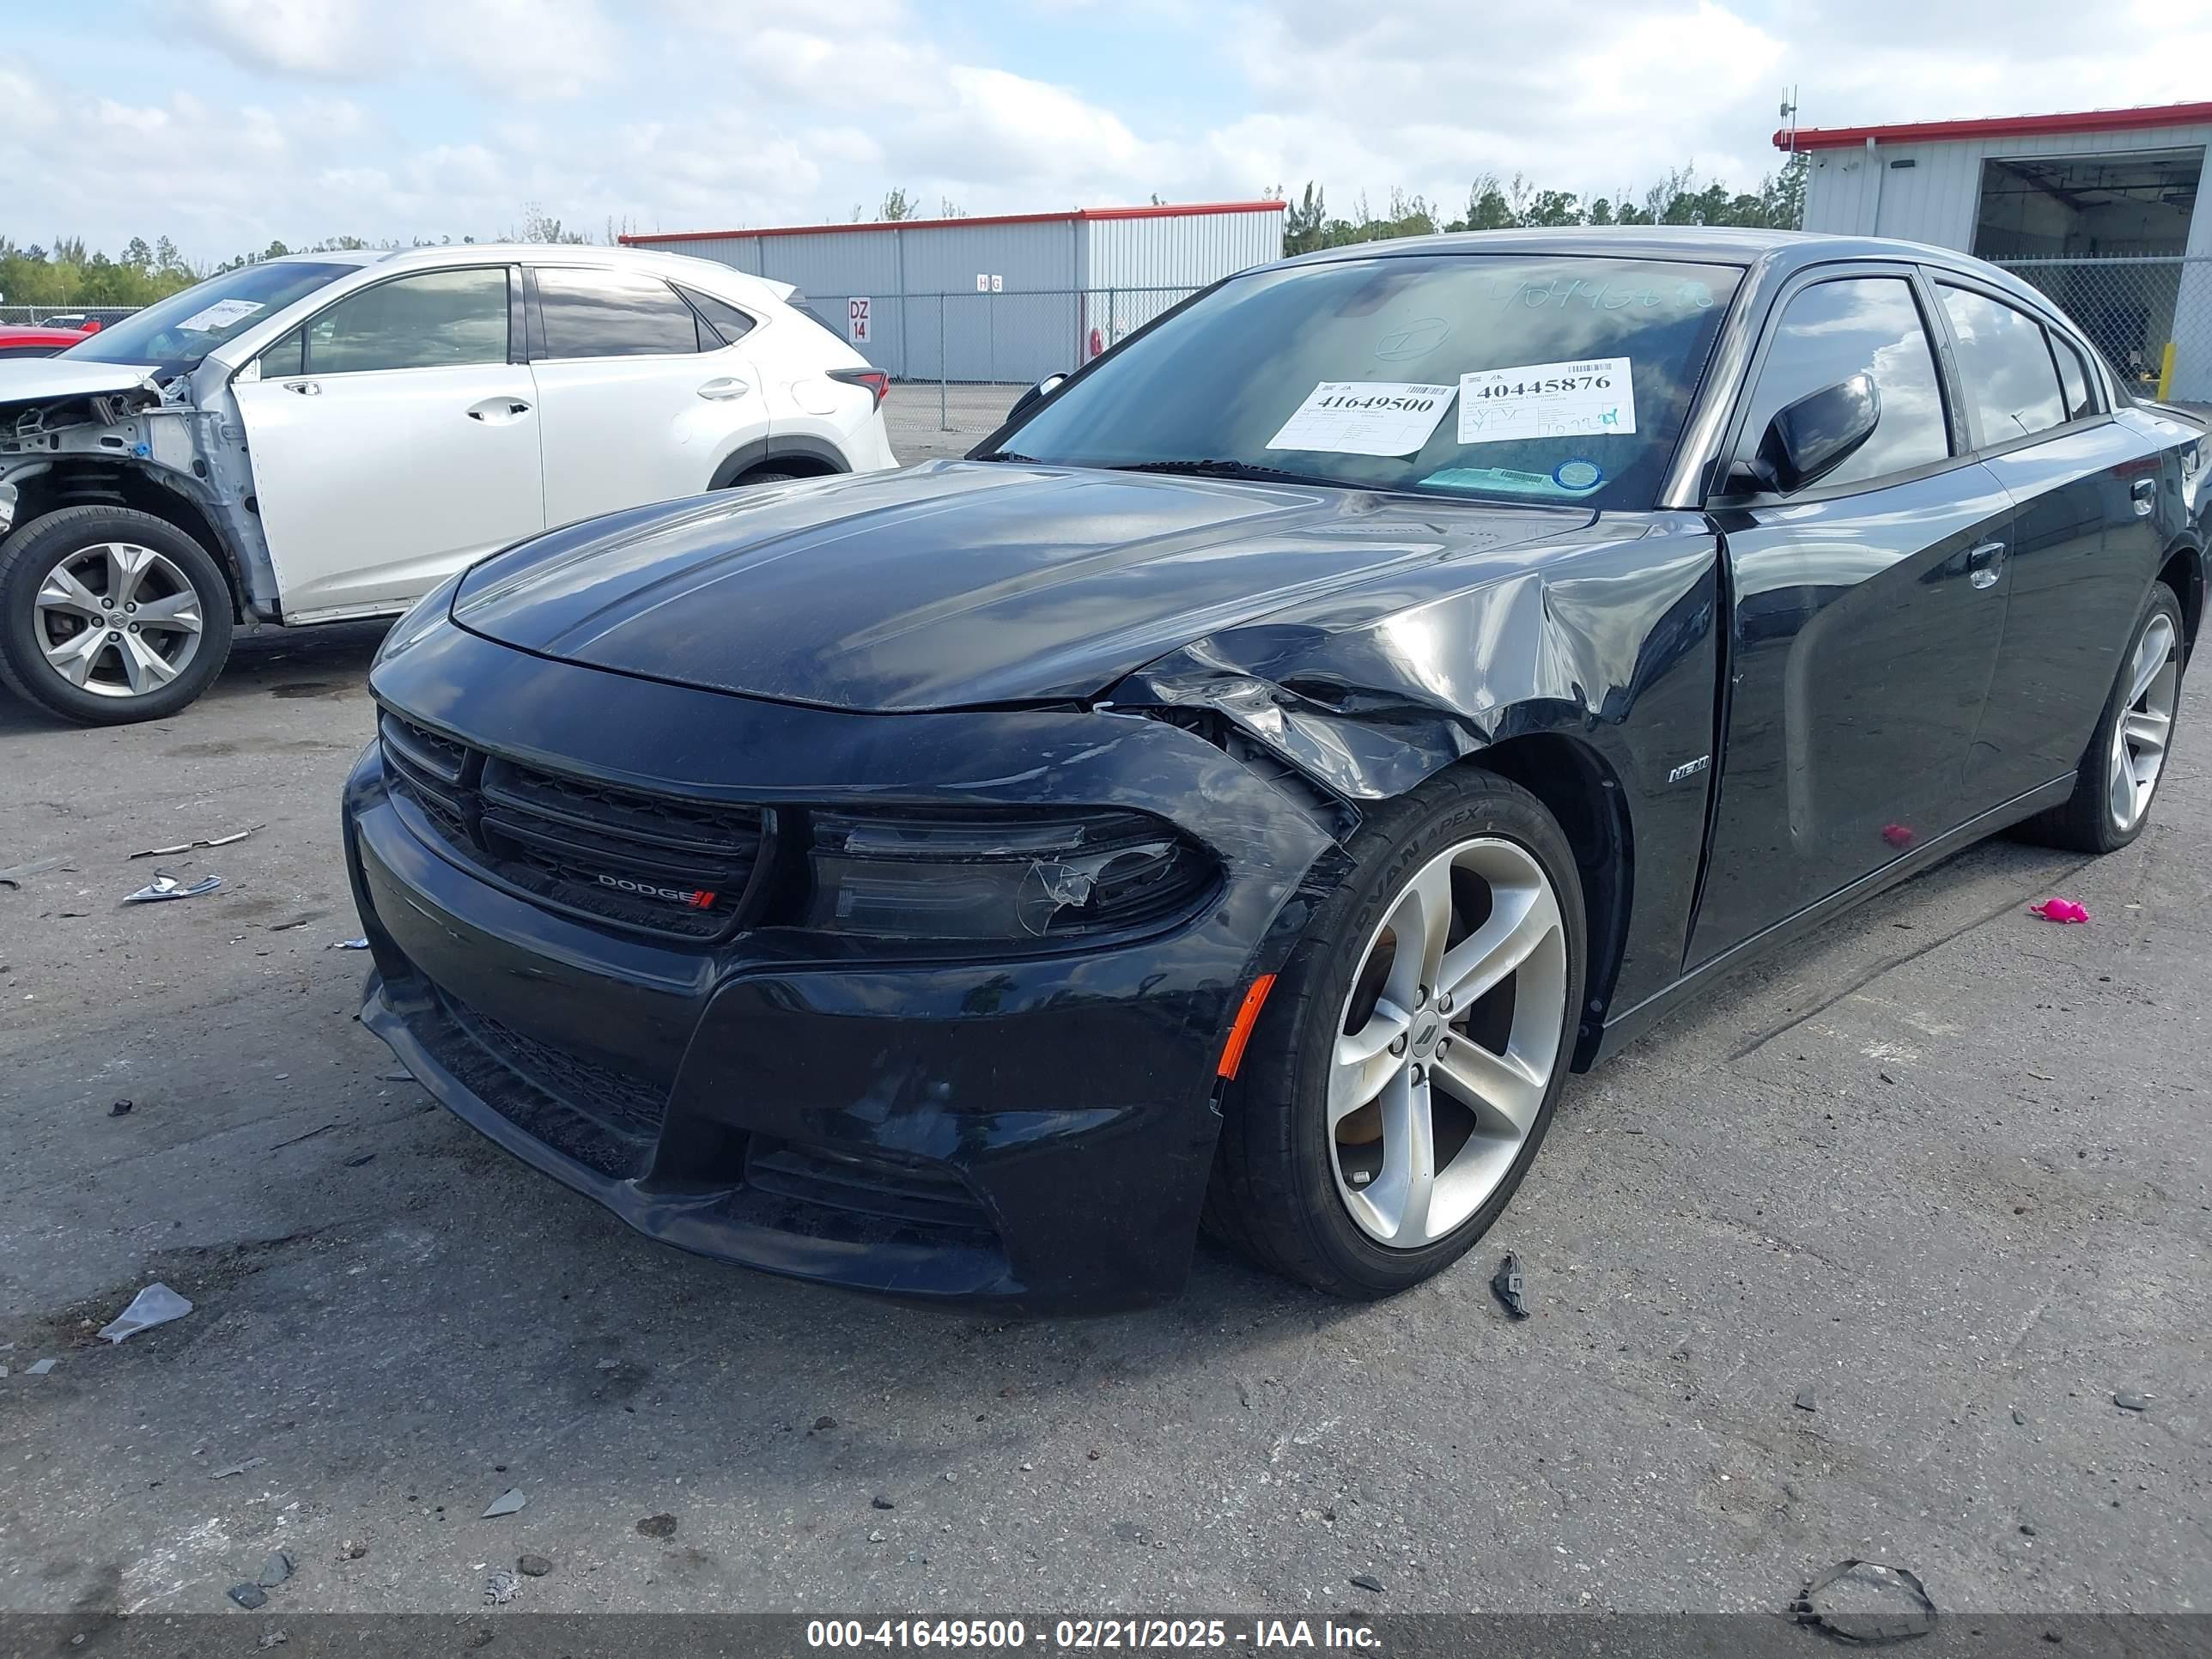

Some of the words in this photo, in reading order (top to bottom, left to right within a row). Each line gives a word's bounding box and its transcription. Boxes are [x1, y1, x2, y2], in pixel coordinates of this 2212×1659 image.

[980, 277, 987, 289] H
[992, 277, 1000, 289] G
[850, 301, 869, 319] DZ
[854, 321, 866, 339] 14
[1476, 374, 1612, 399] 40445876
[1317, 395, 1434, 413] 41649500
[1668, 755, 1710, 783] HEMI
[1424, 805, 1480, 842] APEX
[598, 873, 700, 903] DODGE
